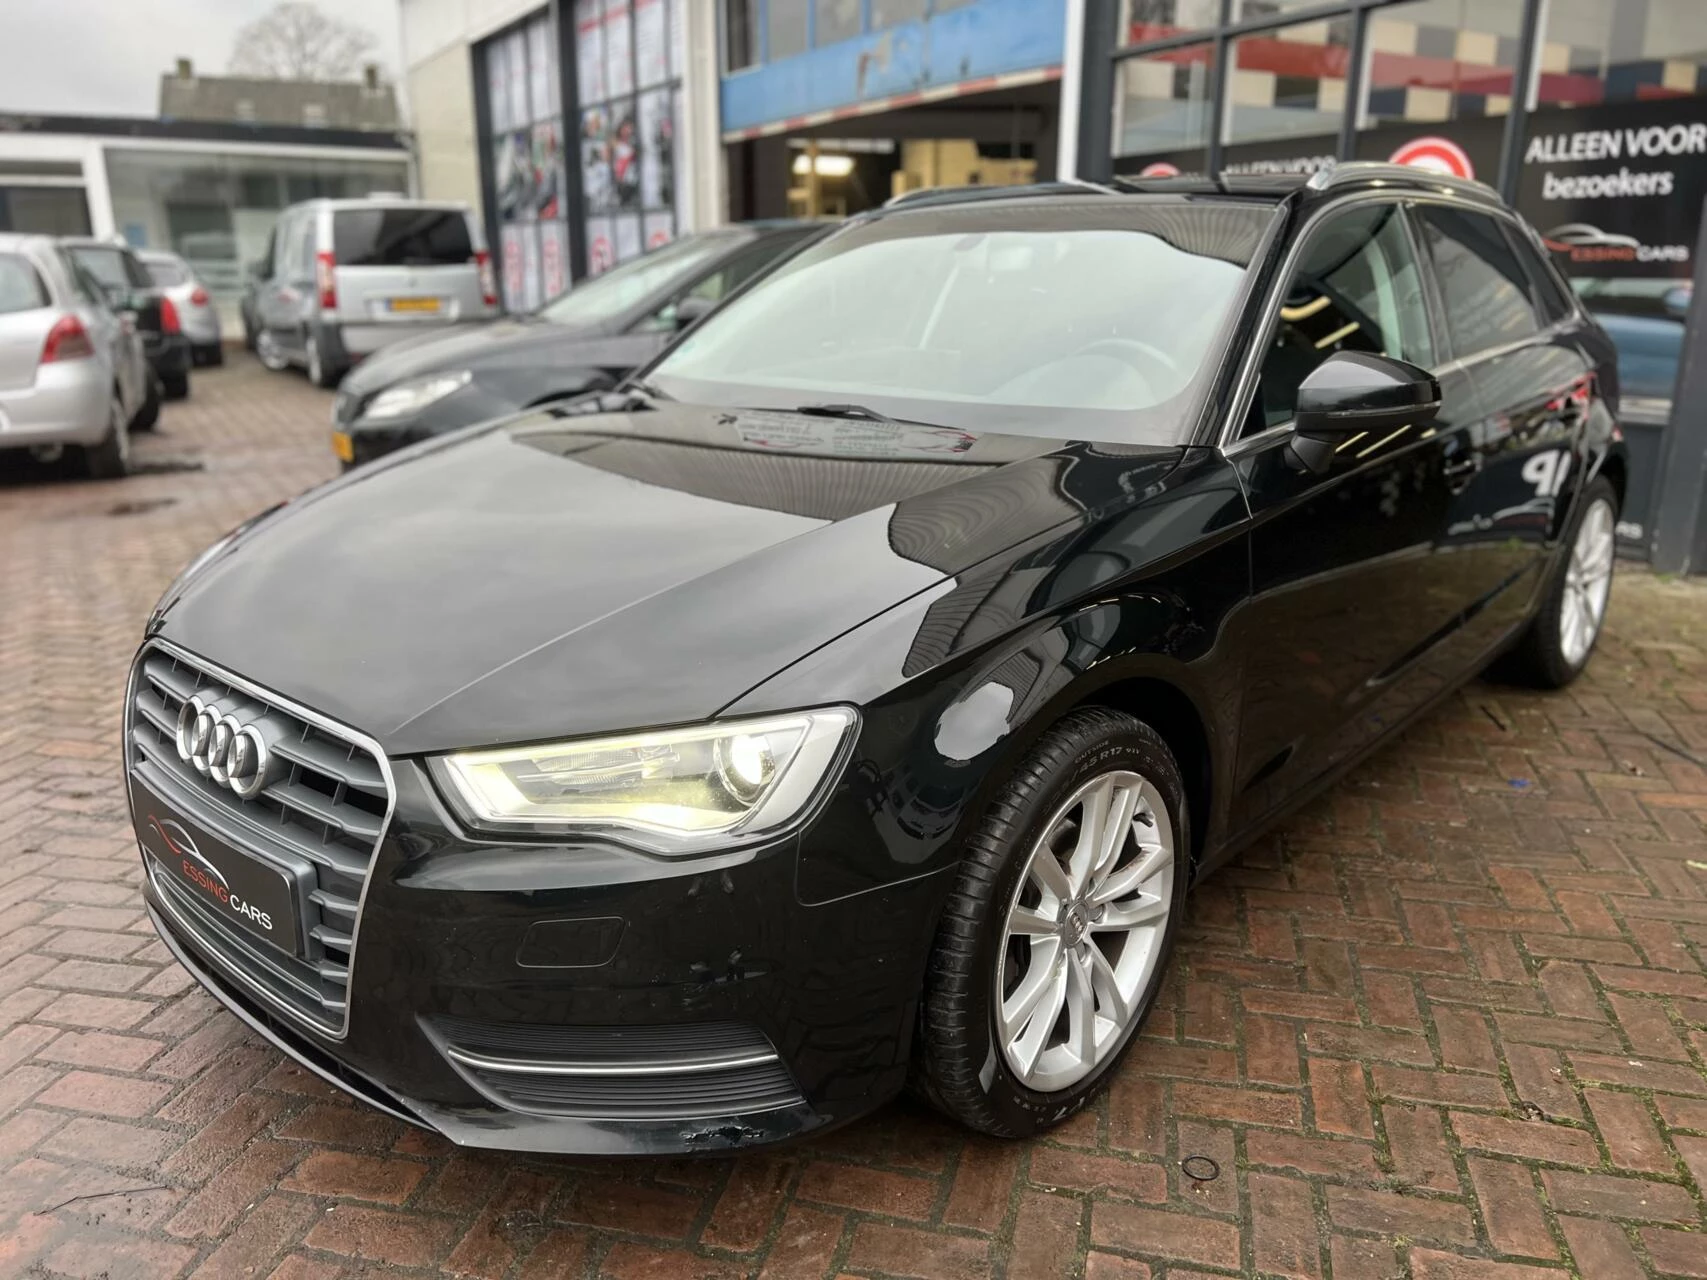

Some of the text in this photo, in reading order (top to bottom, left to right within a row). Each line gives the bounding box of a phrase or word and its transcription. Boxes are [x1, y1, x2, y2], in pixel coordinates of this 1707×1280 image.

[1525, 123, 1707, 164] ALLEEN VOOR
[1542, 166, 1674, 200] bezoekers
[1100, 746, 1123, 760] R17
[229, 894, 273, 930] CARS
